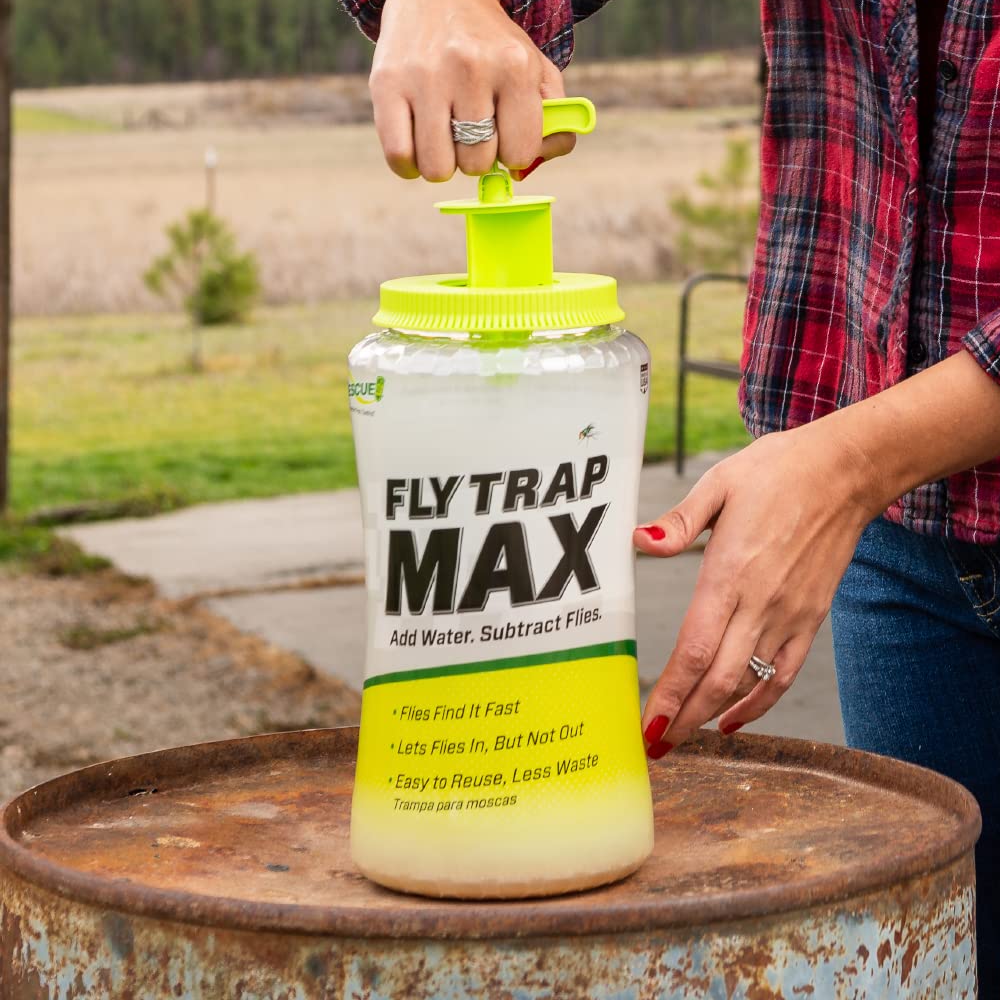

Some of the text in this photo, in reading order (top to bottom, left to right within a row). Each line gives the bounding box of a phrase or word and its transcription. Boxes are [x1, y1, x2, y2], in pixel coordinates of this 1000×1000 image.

[386, 454, 610, 520] FLY TRAP
[385, 502, 611, 616] MAX
[390, 607, 602, 647] Add Water. Subtract Flies.
[400, 700, 521, 721] Flies Find It Fast
[397, 721, 584, 756] Lets Flies In, But Not Out
[395, 754, 599, 793] Easy to Reuse, Less Waste
[394, 795, 518, 813] Trampa para moscas
